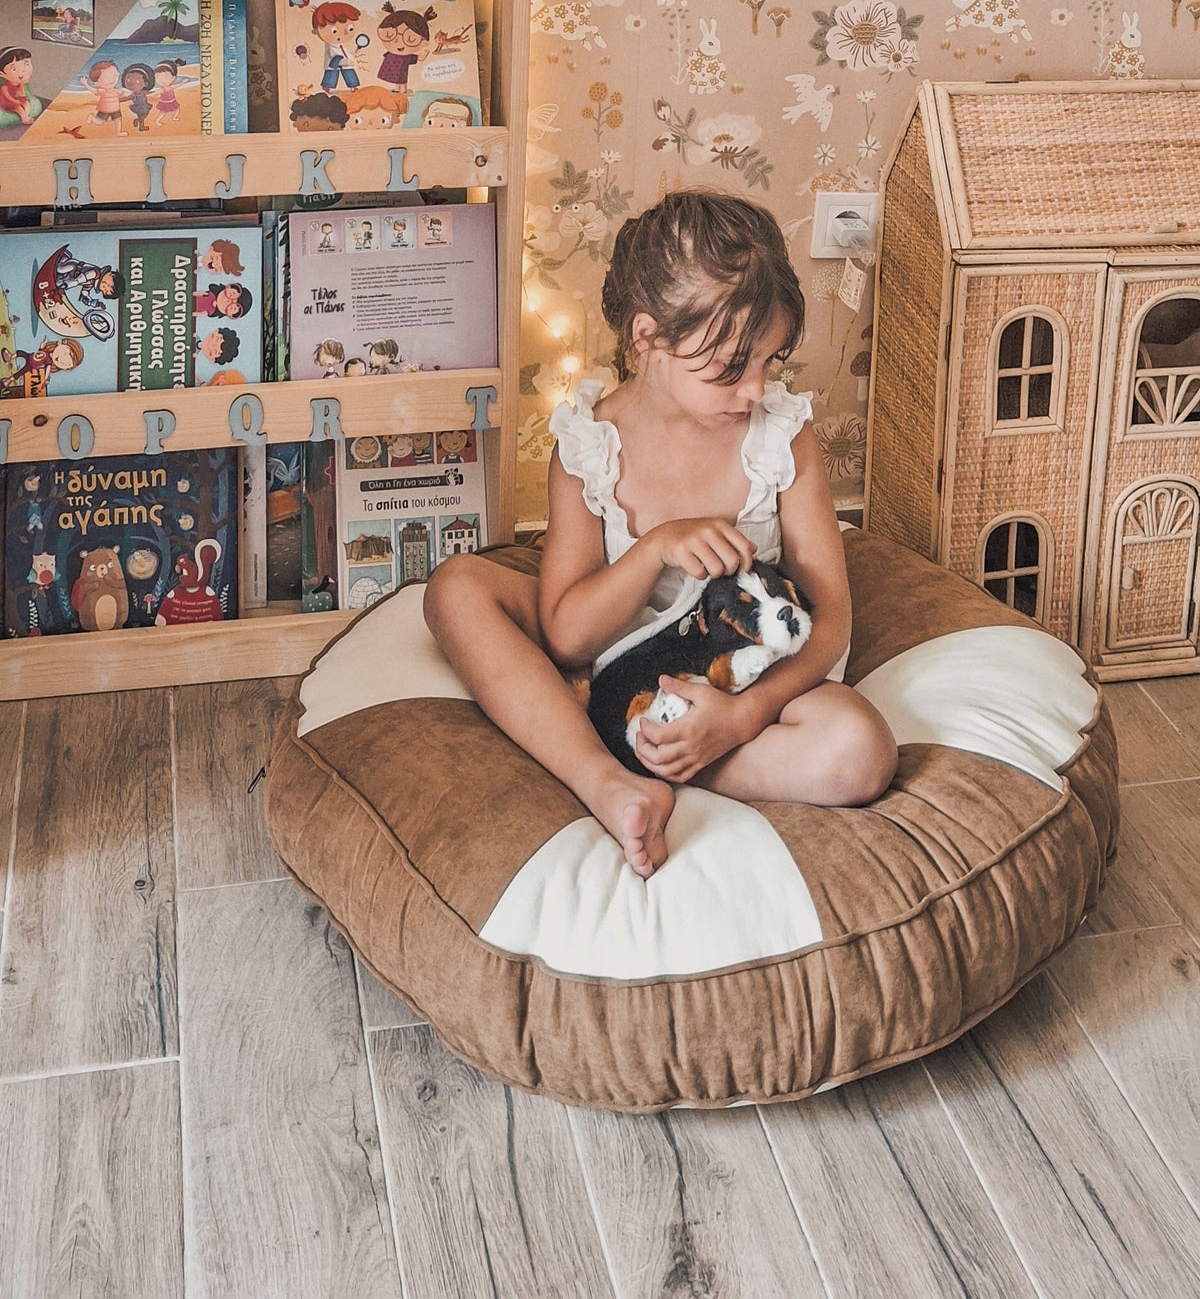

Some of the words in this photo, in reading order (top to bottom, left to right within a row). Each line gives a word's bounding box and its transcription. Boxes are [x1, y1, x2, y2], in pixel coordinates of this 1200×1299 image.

[200, 14, 212, 38] ΖΩΗ
[200, 44, 212, 79] ΜΕΣΑ
[200, 83, 212, 108] ΣΤΟ
[53, 159, 94, 205] H
[145, 156, 168, 203] I
[214, 153, 246, 199] J
[299, 149, 336, 195] K
[386, 147, 419, 191] L
[130, 257, 143, 285] και
[304, 305, 313, 314] οι
[315, 300, 345, 314] Πάνες
[311, 287, 337, 301] Τέλος
[148, 289, 169, 369] Γλώσσας
[57, 414, 95, 460] O
[143, 409, 176, 455] P
[228, 393, 267, 445] Q
[309, 397, 345, 442] R
[466, 385, 498, 430] T
[54, 471, 65, 484] Η
[67, 465, 167, 496] δύναμη
[66, 495, 93, 507] της
[363, 499, 373, 511] Τα
[376, 497, 409, 511] σπίτια
[411, 499, 426, 508] του
[428, 495, 461, 509] κόσμου
[58, 500, 164, 536] αγάπης
